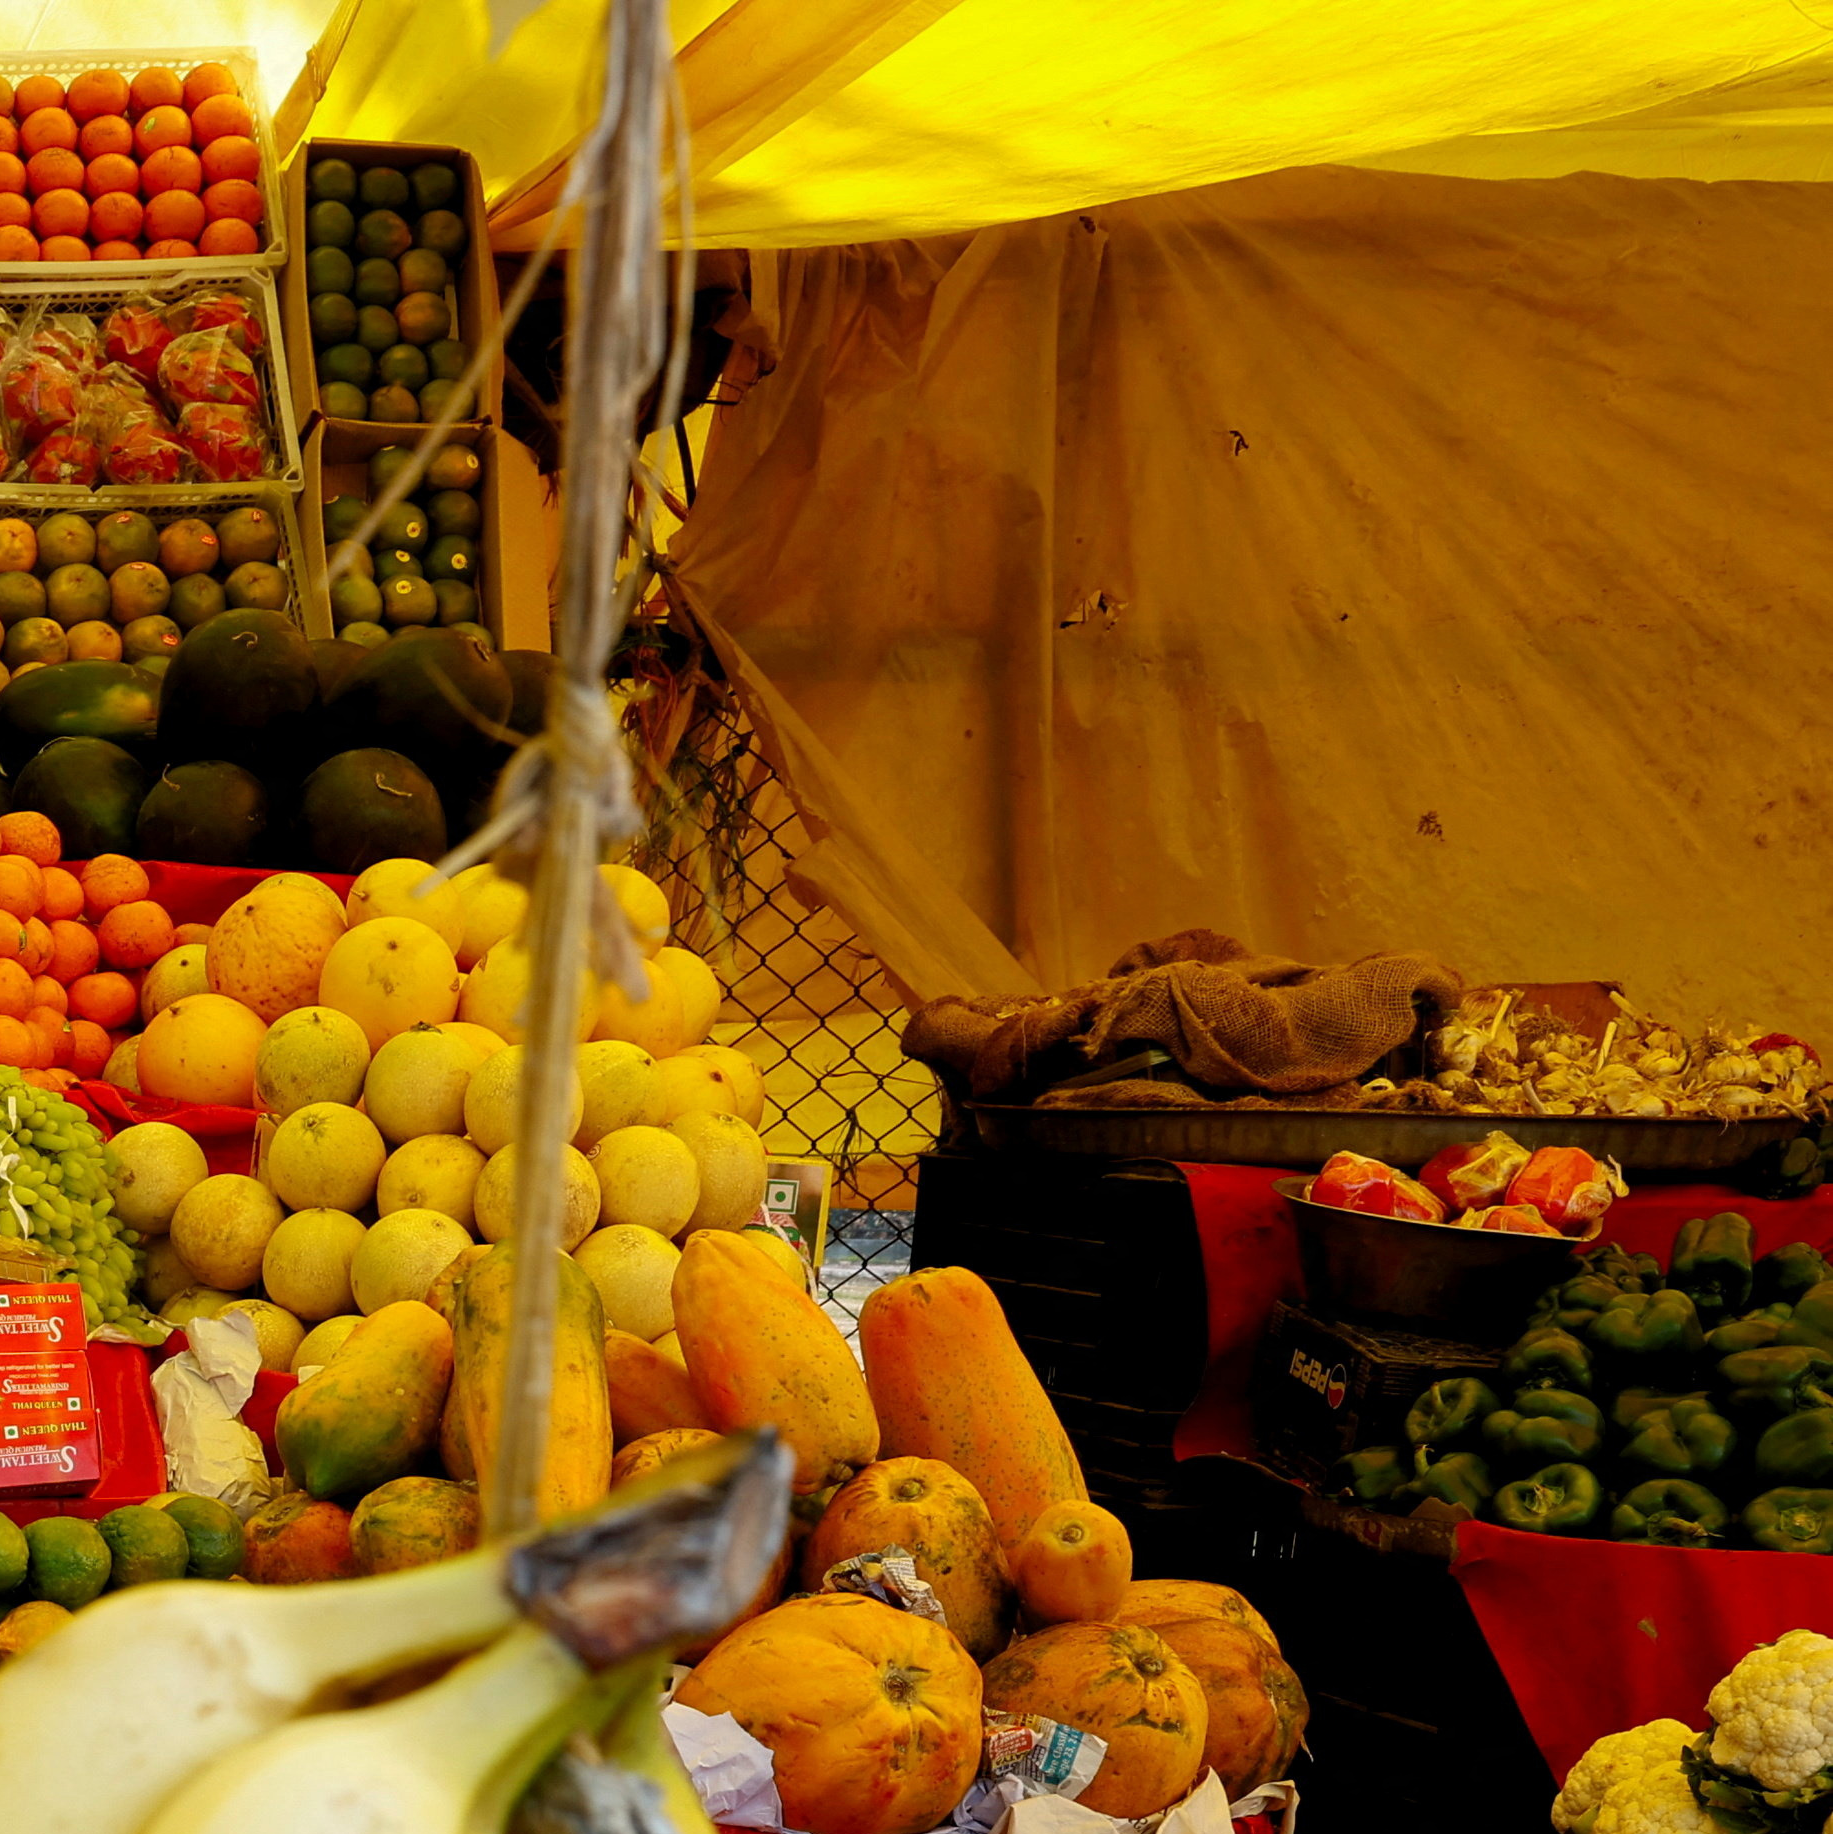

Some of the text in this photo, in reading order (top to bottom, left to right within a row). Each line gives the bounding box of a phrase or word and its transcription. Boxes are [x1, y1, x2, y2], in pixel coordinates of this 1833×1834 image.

[13, 1295, 72, 1305] THAI QUEEN
[25, 1316, 64, 1342] SWEET
[1290, 1348, 1326, 1396] PEPSI
[2, 1379, 69, 1394] SWEET TAMARIND
[12, 1401, 63, 1410] THAI QUEEN
[22, 1421, 87, 1436] THAI QUEEN
[19, 1444, 47, 1453] PREMIUM
[31, 1446, 77, 1473] SWEET
